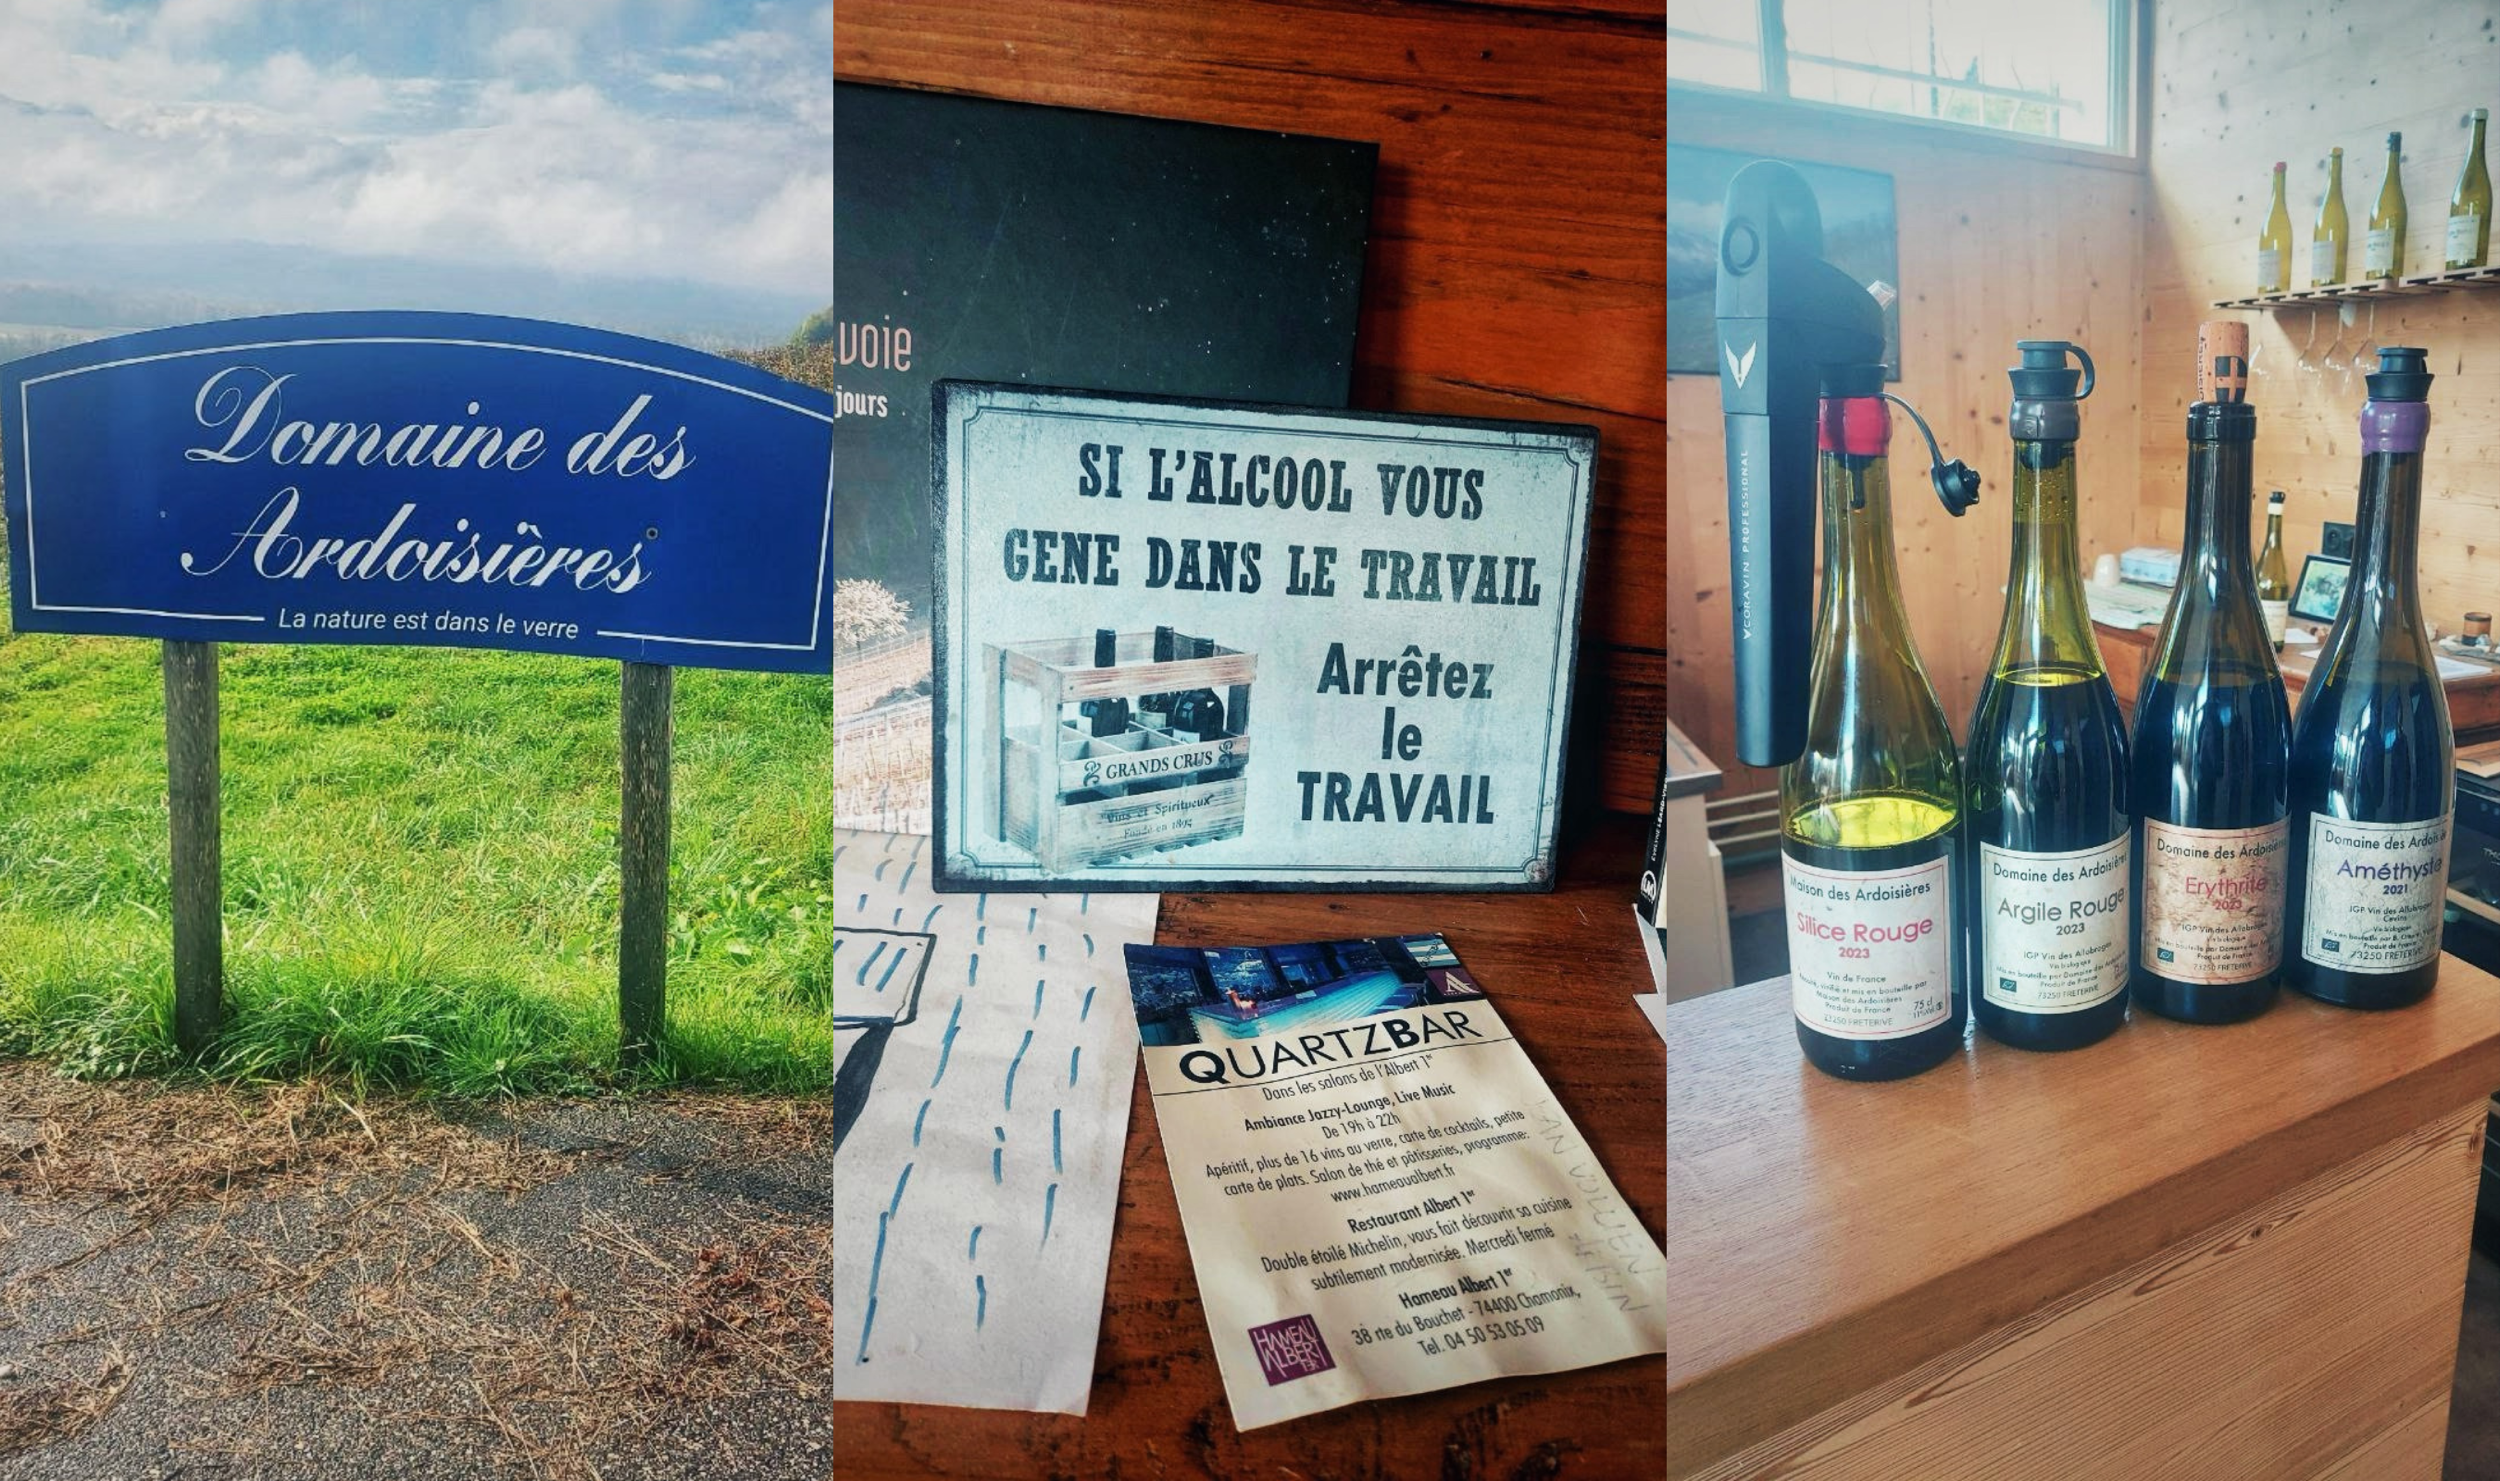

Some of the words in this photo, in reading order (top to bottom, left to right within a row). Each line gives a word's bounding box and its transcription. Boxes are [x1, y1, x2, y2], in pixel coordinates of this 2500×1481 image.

[833, 314, 912, 372] voie
[184, 366, 546, 470] Domaine
[567, 394, 696, 480] des
[1079, 442, 1123, 498] SI
[1148, 447, 1352, 513] L'ALCOOL
[1377, 463, 1484, 520] VOUS
[1741, 450, 1750, 553] PROFESSIONAL
[180, 487, 652, 594] Ardoisières
[1003, 528, 1119, 586] GENE
[1145, 536, 1261, 594] DANS
[1285, 545, 1337, 597] LE
[1360, 548, 1541, 606] TRAVAIL
[1742, 561, 1751, 628] CORAVIN
[278, 608, 306, 628] La
[313, 610, 386, 629] nature
[393, 612, 428, 630] est
[435, 610, 489, 633] dans
[496, 613, 515, 633] le
[523, 619, 579, 639] verre
[1317, 642, 1494, 699] Arrêtez
[1382, 706, 1422, 761] le
[1106, 757, 1169, 779] GRANDS
[1173, 751, 1213, 770] CRUS
[1297, 771, 1494, 824] TRAVAIL
[2157, 838, 2210, 859] Domaine
[2214, 846, 2235, 859] des
[2325, 830, 2380, 849] Domaine
[2385, 836, 2405, 850] des
[1790, 875, 1824, 898] Maison
[1828, 885, 1850, 901] des
[1855, 882, 1931, 901] Ardoisières
[1993, 862, 2047, 882] Domaine
[2052, 867, 2074, 882] des
[2186, 875, 2267, 899] Erythrite
[2337, 857, 2443, 881] Améthyste
[1998, 897, 2062, 925] Argile
[2070, 887, 2125, 919] Rouge
[2383, 884, 2408, 895] 2021
[1797, 912, 1846, 942] Silice
[1854, 918, 1933, 943] Rouge
[2056, 923, 2085, 935] 2023
[1838, 947, 1870, 959] 2023
[2042, 952, 2055, 960] Vin
[2059, 951, 2072, 960] des
[1827, 972, 1840, 981] Vin
[1846, 973, 1854, 982] de
[1856, 974, 1887, 983] France
[1914, 1001, 1925, 1011] 75
[1179, 1010, 1483, 1085] QUARTZBAR
[1262, 1086, 1295, 1102] Dans
[1297, 1080, 1316, 1095] les
[1318, 1071, 1358, 1090] salons
[1359, 1066, 1375, 1082] de
[1244, 1112, 1306, 1131] Ambiance
[1307, 1094, 1396, 1122] Jazzy-Lounge,
[1394, 1089, 1420, 1104] Live
[1421, 1084, 1456, 1099] Music
[1322, 1125, 1339, 1139] De
[1340, 1118, 1365, 1136] 19h
[1367, 1117, 1375, 1130] à
[1376, 1112, 1401, 1127] 22h
[1206, 1157, 1254, 1180] Apéritif,
[1256, 1155, 1282, 1173] plus
[1284, 1152, 1299, 1166] de
[1300, 1148, 1318, 1164] 16
[1320, 1146, 1345, 1161] vins
[1347, 1143, 1362, 1157] au
[1363, 1136, 1397, 1152] verre,
[1398, 1131, 1426, 1145] carte
[1427, 1125, 1442, 1140] de
[1443, 1118, 1494, 1137] cocktails,
[1494, 1109, 1525, 1128] petite
[1224, 1180, 1255, 1196] carte
[1257, 1177, 1273, 1192] de
[1275, 1174, 1309, 1191] plats.
[1310, 1167, 1346, 1183] Salon
[1347, 1163, 1363, 1178] de
[1364, 1157, 1385, 1173] thé
[1387, 1155, 1399, 1169] et
[1401, 1144, 1463, 1168] pâtisseries,
[1463, 1130, 1530, 1155] programme:
[1331, 1163, 1456, 1203] www.hameaualbert.fr
[1347, 1205, 1422, 1233] Restaurant
[1423, 1196, 1461, 1216] Albert
[1260, 1251, 1309, 1273] Double
[1311, 1245, 1347, 1265] étoilé
[1347, 1234, 1407, 1259] Michelin,
[1407, 1226, 1438, 1244] vous
[1435, 1219, 1461, 1237] fait
[1462, 1207, 1516, 1230] découvrir
[1516, 1205, 1532, 1218] sa
[1532, 1196, 1572, 1215] cuisine
[1311, 1263, 1387, 1291] subtilement
[1389, 1245, 1466, 1274] modernisée.
[1465, 1233, 1519, 1256] Mercredi
[1517, 1222, 1555, 1242] fermé
[1399, 1283, 1457, 1309] Hameau
[1457, 1275, 1498, 1297] Albert
[1351, 1326, 1373, 1346] 38
[1394, 1320, 1413, 1338] du
[1413, 1307, 1465, 1332] Bouchet
[1473, 1296, 1518, 1317] 74400
[1517, 1283, 1582, 1309] Chamonix,
[1417, 1338, 1445, 1356] Tel.
[1443, 1332, 1466, 1350] 04
[1466, 1326, 1486, 1345] 50
[1486, 1322, 1507, 1341] 53
[1507, 1318, 1526, 1338] 05
[1525, 1314, 1545, 1334] 09
